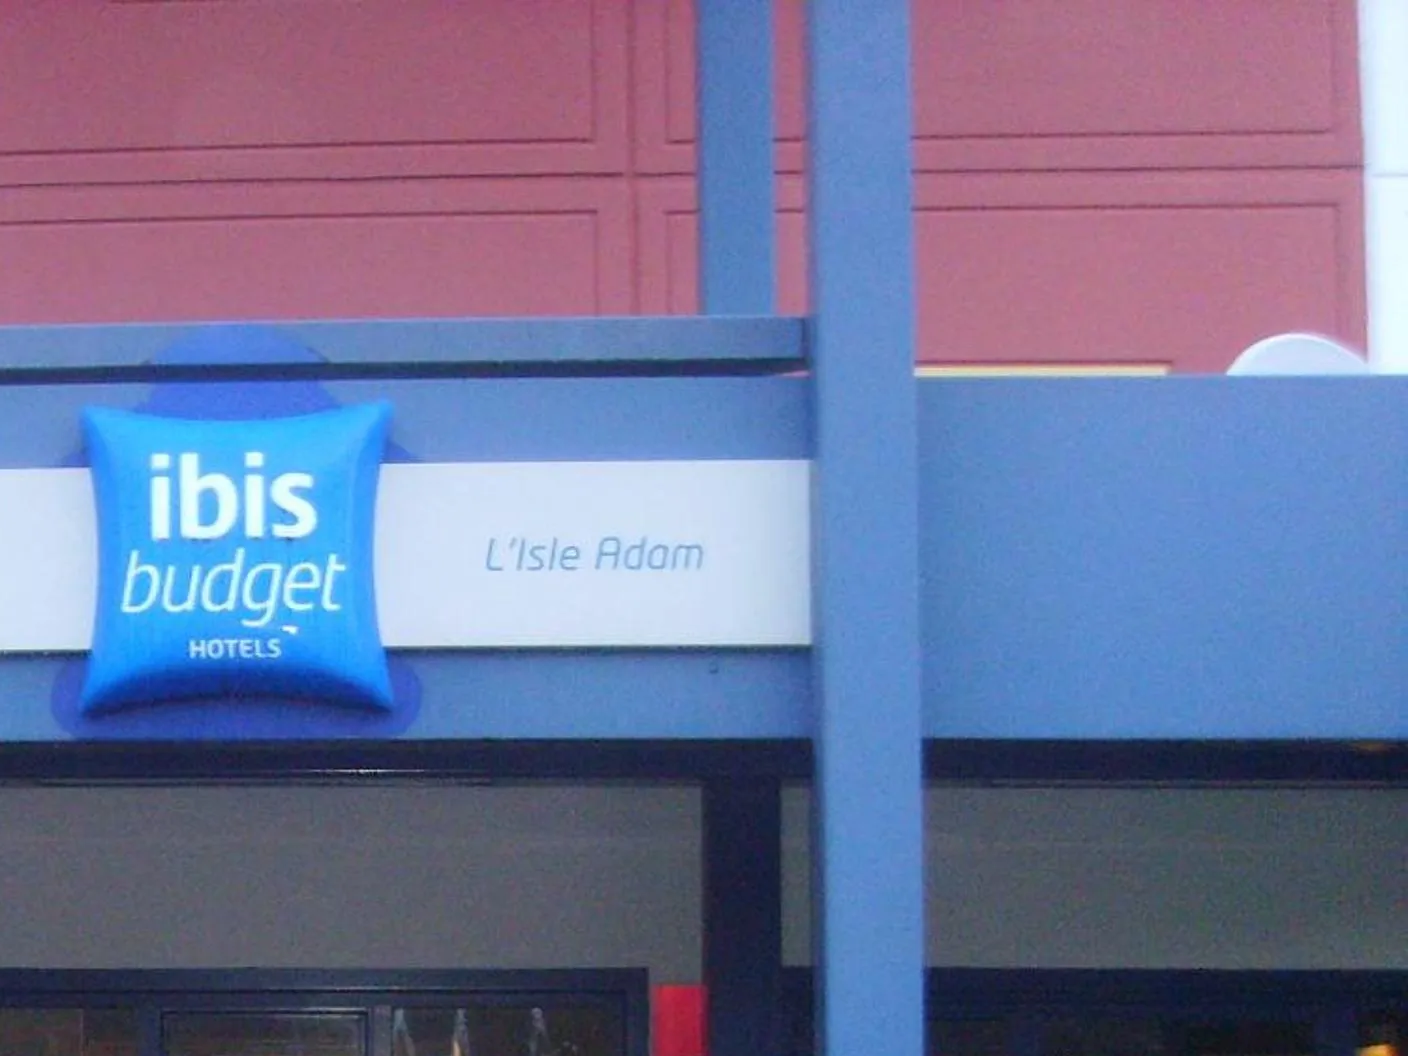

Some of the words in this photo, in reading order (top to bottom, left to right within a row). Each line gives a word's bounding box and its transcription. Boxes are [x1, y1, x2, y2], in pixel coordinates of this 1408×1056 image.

[151, 451, 318, 540] ibis
[486, 537, 580, 572] L'Isle
[594, 536, 704, 570] Adam
[120, 547, 347, 628] budget
[189, 639, 282, 659] HOTELS
